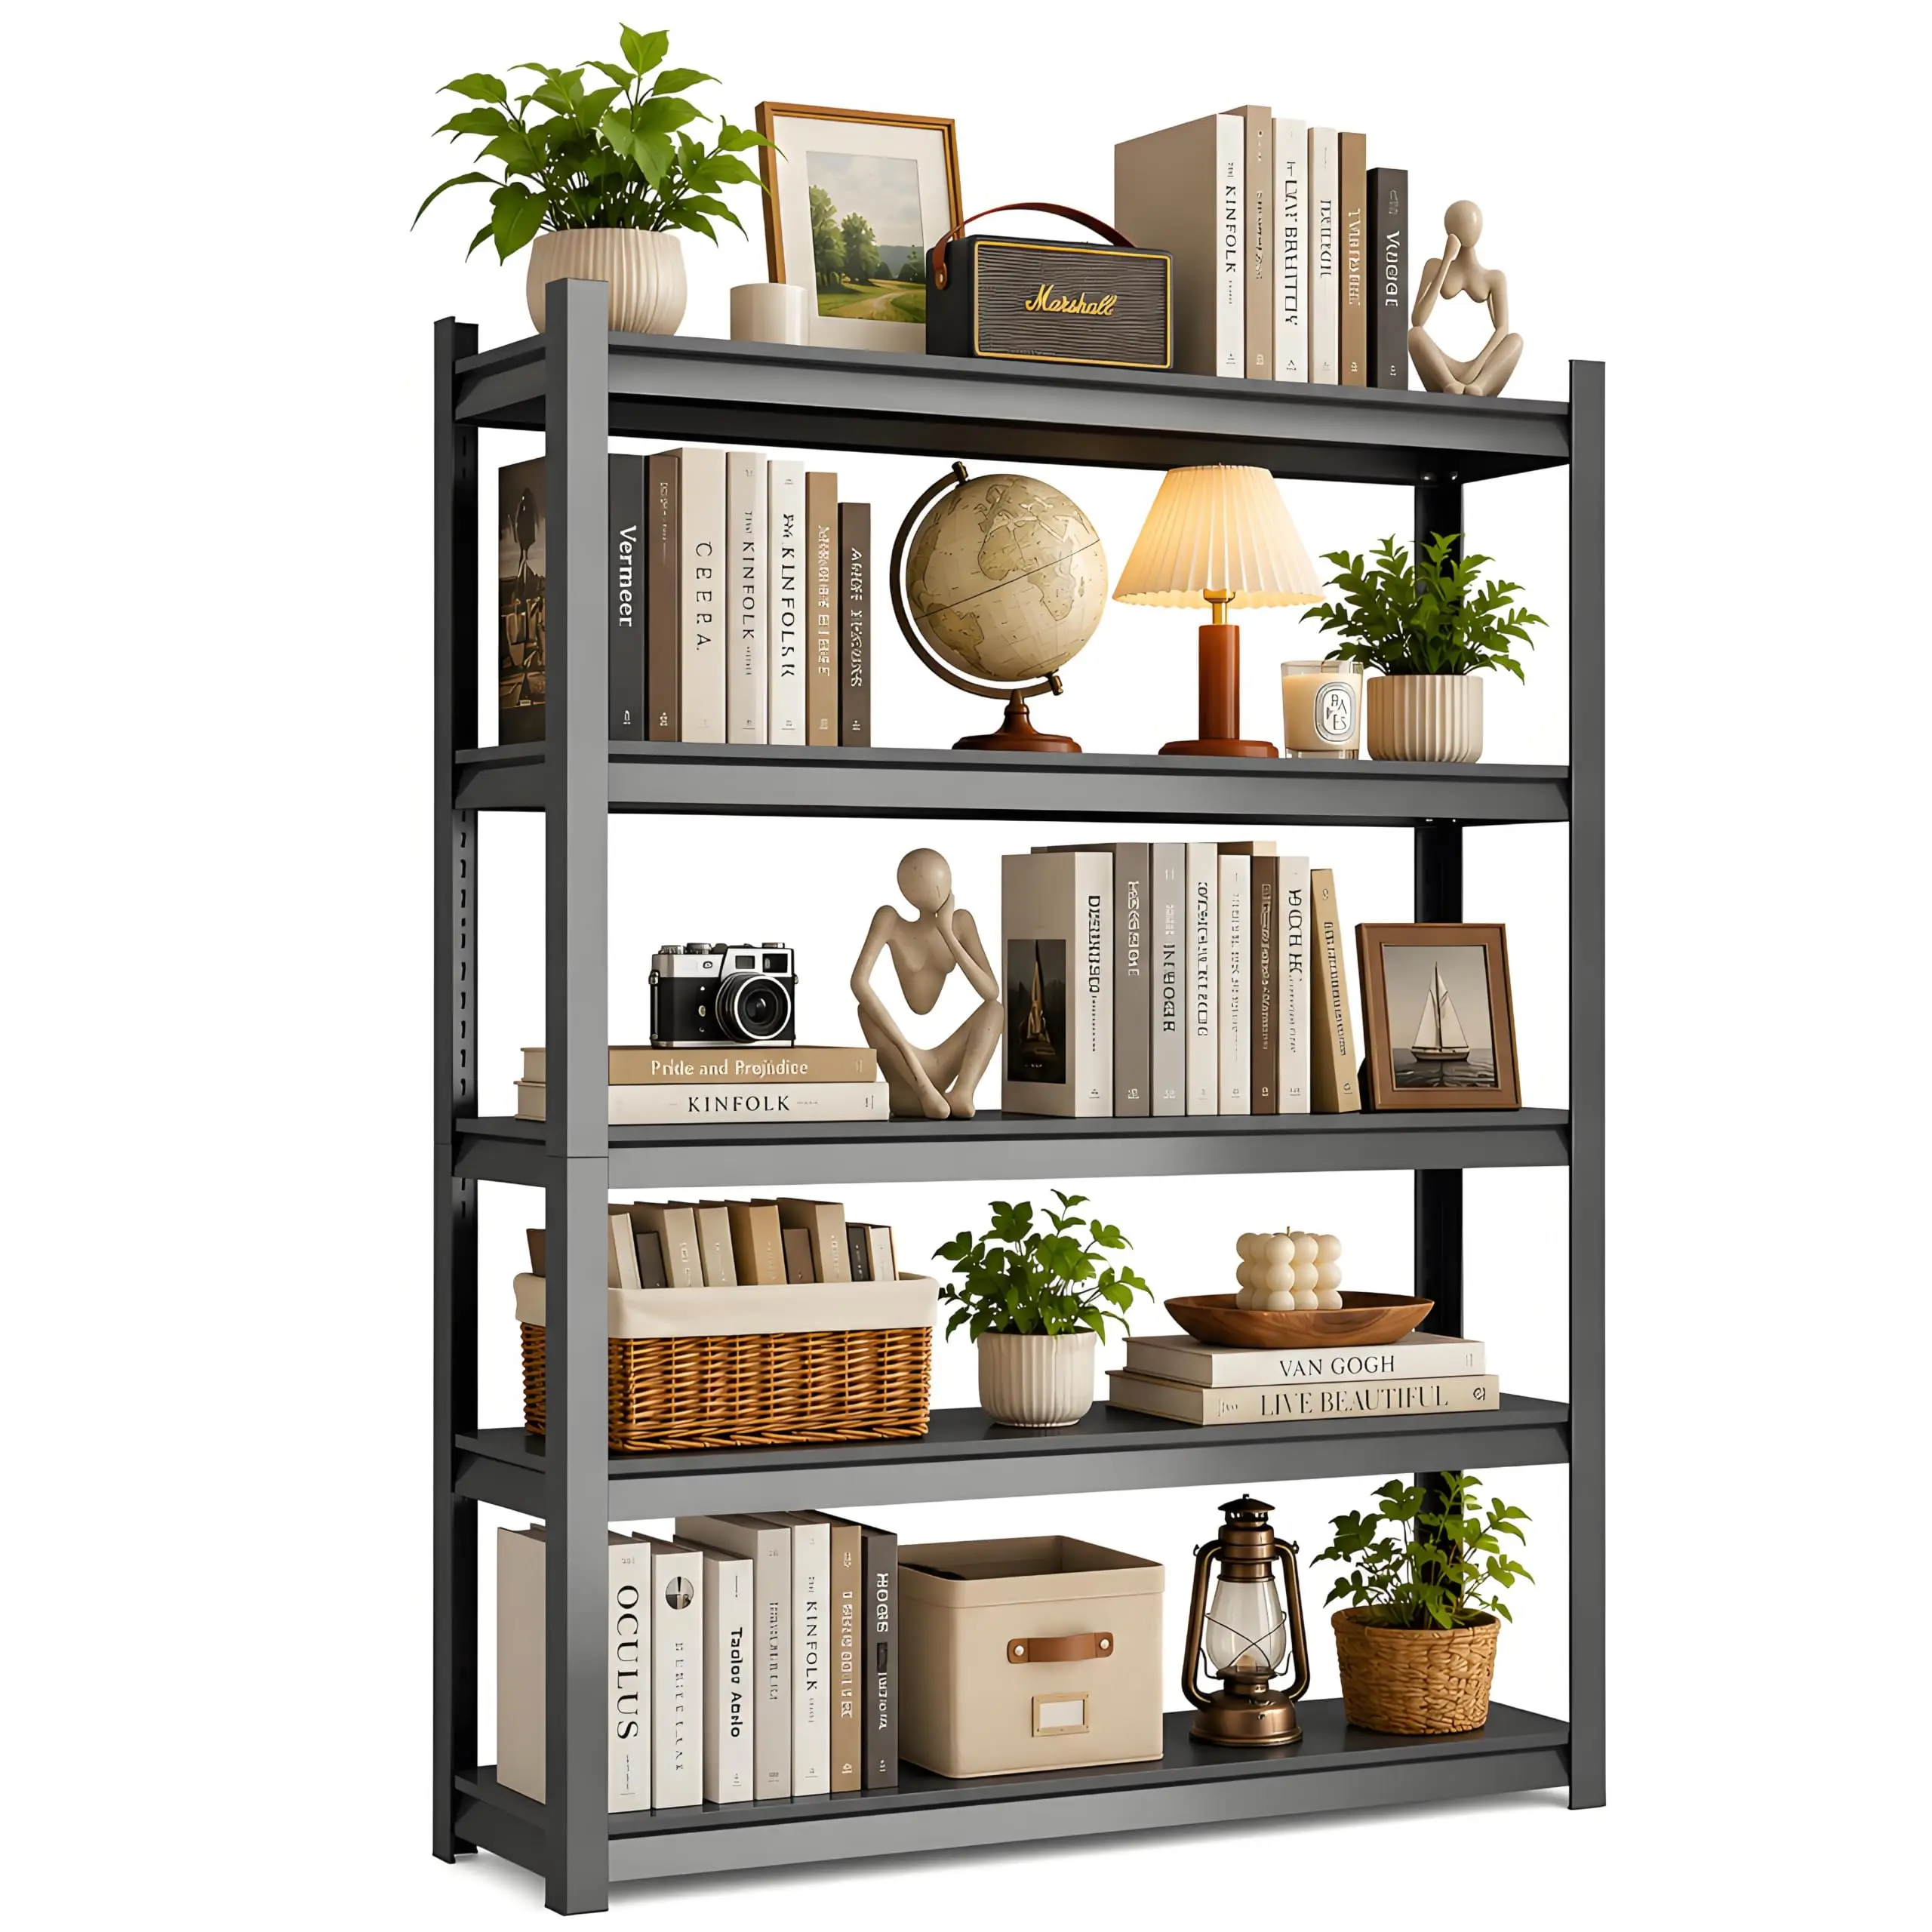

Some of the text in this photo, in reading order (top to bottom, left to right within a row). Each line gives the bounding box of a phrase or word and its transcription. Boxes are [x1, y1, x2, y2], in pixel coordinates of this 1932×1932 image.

[1226, 185, 1237, 273] KINFOLK
[1025, 283, 1118, 316] Marshall
[619, 525, 637, 627] Vermeer
[743, 541, 755, 639] KINFOLK
[699, 1058, 728, 1075] and
[688, 1095, 790, 1112] KINFOLK
[1279, 1355, 1395, 1377] VAN GOGH
[1261, 1392, 1313, 1417] LIVE
[1321, 1385, 1448, 1413] BEAUTIFUL
[617, 1585, 639, 1740] OCULUS
[806, 1601, 818, 1691] KINFOLK
